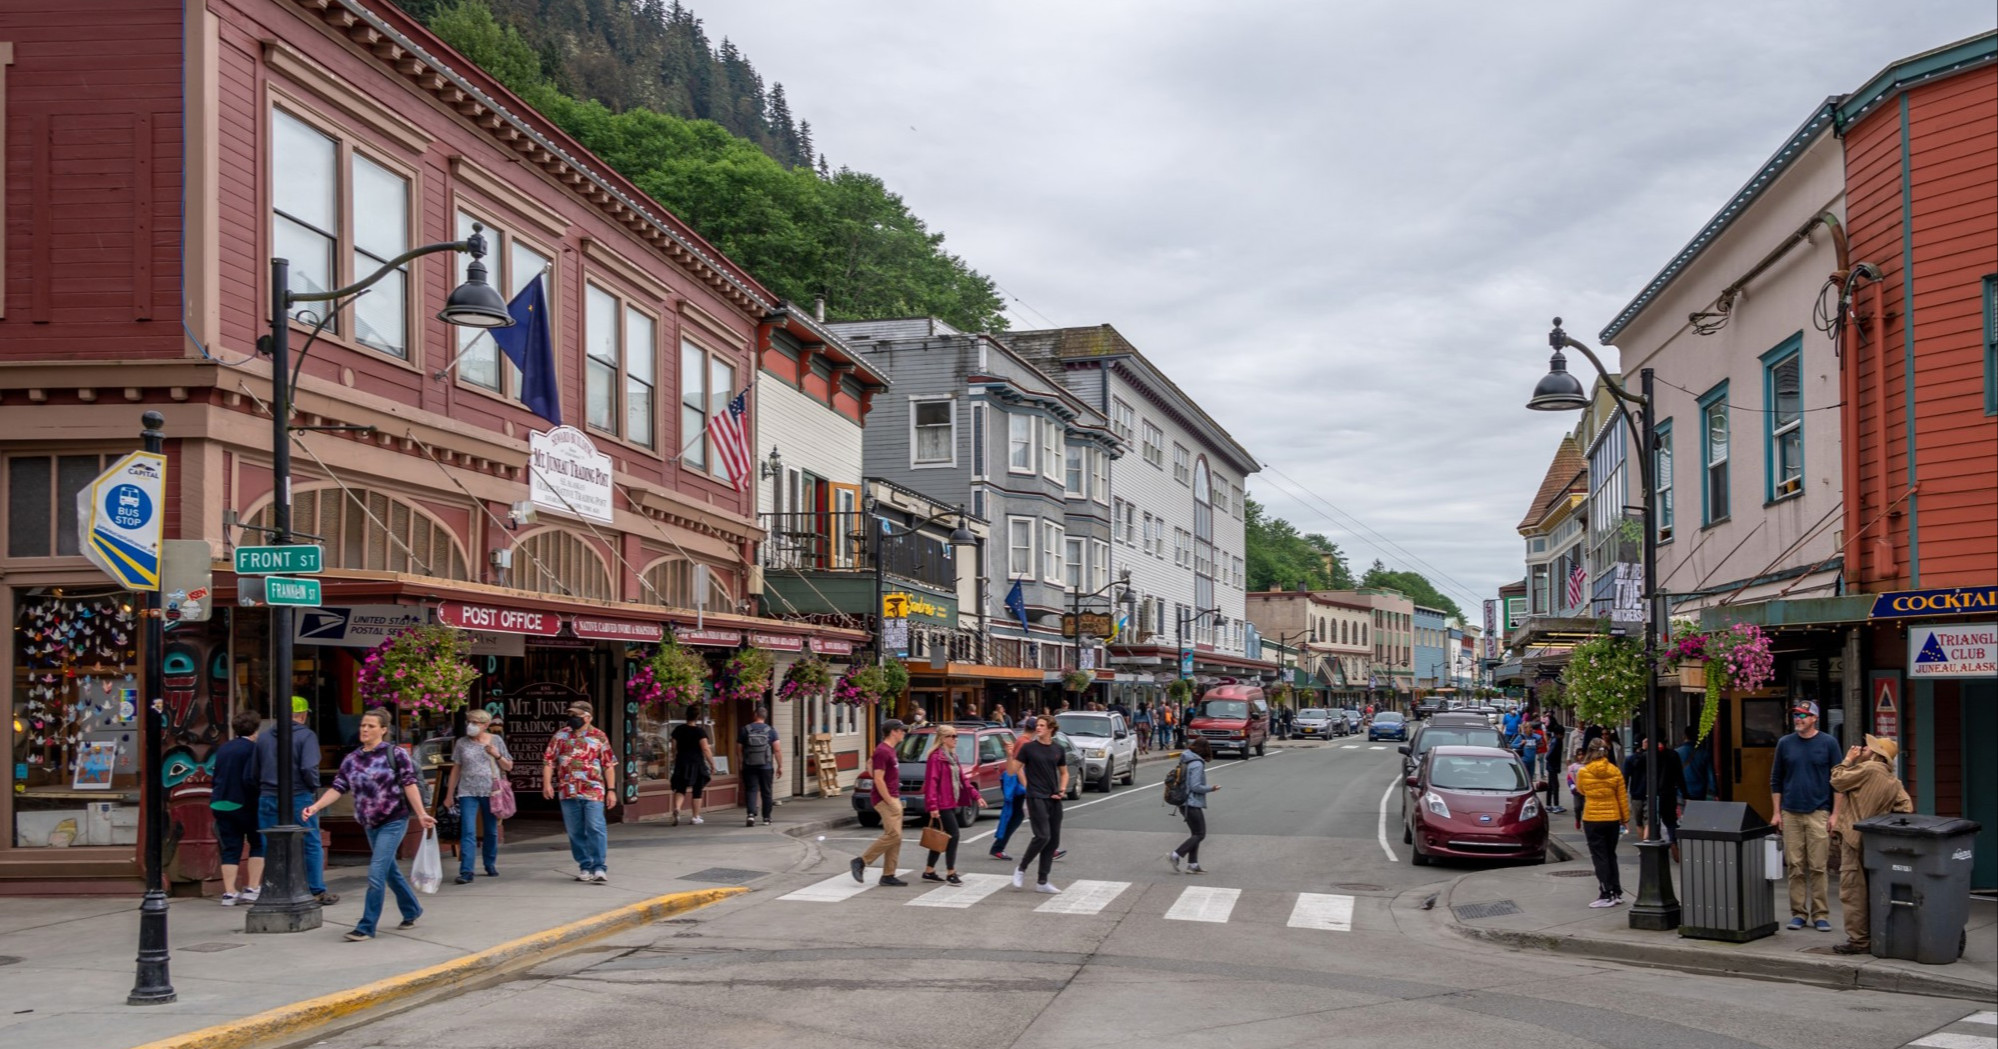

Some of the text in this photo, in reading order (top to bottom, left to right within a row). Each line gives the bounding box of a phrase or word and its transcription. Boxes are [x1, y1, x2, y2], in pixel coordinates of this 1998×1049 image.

[128, 469, 160, 479] CAPITAL
[118, 507, 140, 517] BUS
[115, 516, 142, 526] STOP
[240, 552, 315, 568] FRONT ST
[271, 583, 316, 600] FRANKLIN ST
[1614, 579, 1643, 609] TIDE
[1892, 591, 1998, 611] COCKTAI
[353, 616, 386, 624] UNITED
[462, 606, 543, 630] POST OFFICE
[350, 626, 384, 635] POSTAL
[1937, 633, 1998, 646] TRIANGL
[1951, 648, 1986, 660] CLUB
[1915, 662, 1998, 674] JUNEAU, ALASK
[508, 698, 569, 720] MT. JUNE
[508, 721, 555, 733] TRADING
[509, 743, 545, 752] OLDEST
[512, 752, 545, 761] TRADI
